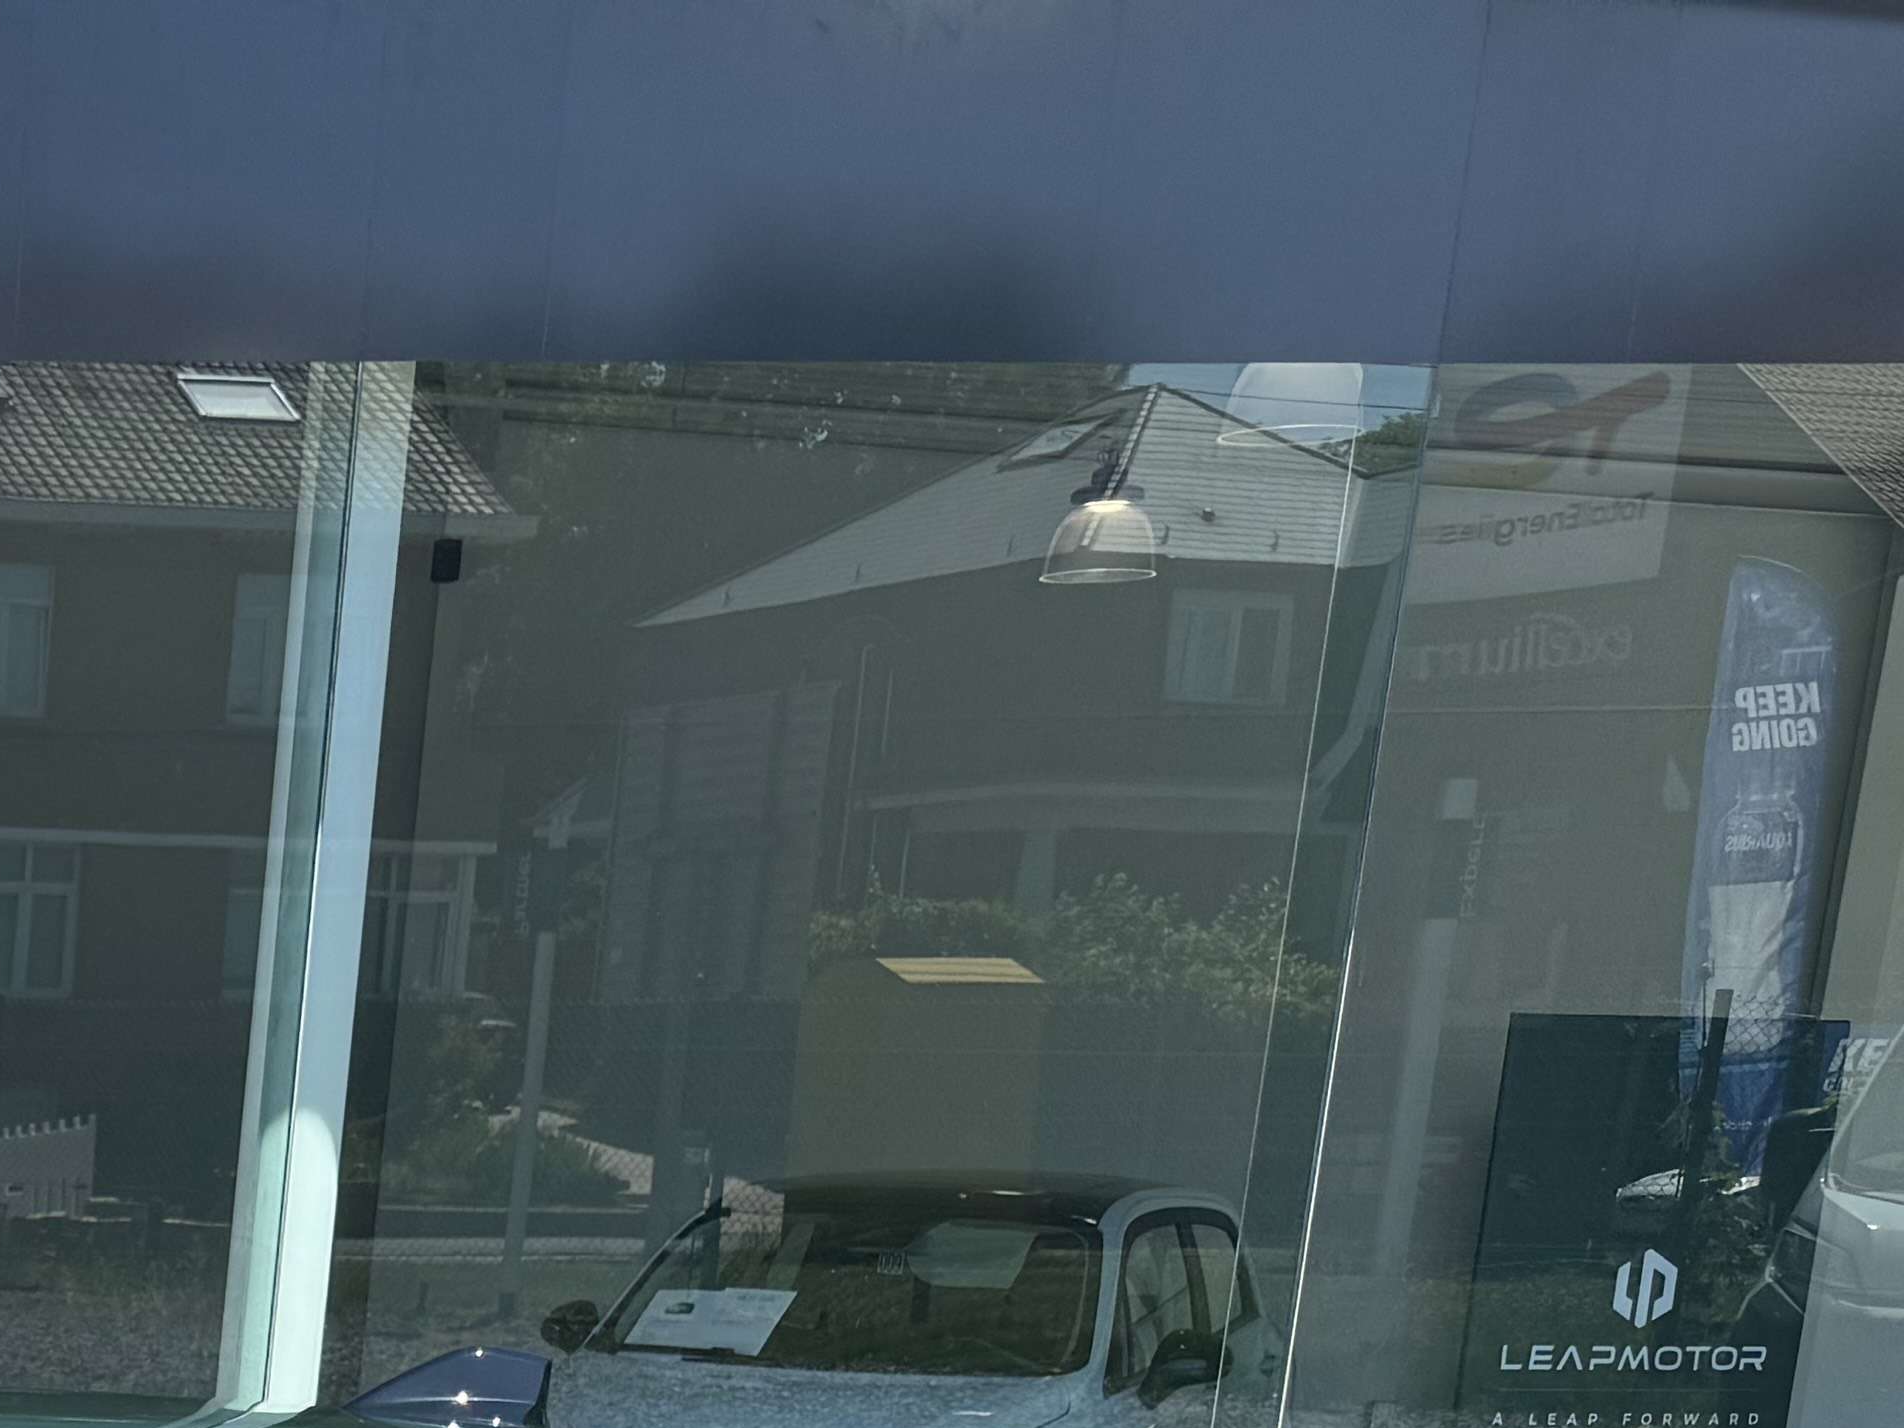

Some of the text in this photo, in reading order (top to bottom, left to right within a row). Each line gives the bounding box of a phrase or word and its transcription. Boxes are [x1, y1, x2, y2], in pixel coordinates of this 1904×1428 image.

[1499, 1344, 1769, 1372] LEAPMOTOR
[1492, 1412, 1761, 1427] A LEAP FORWARD
